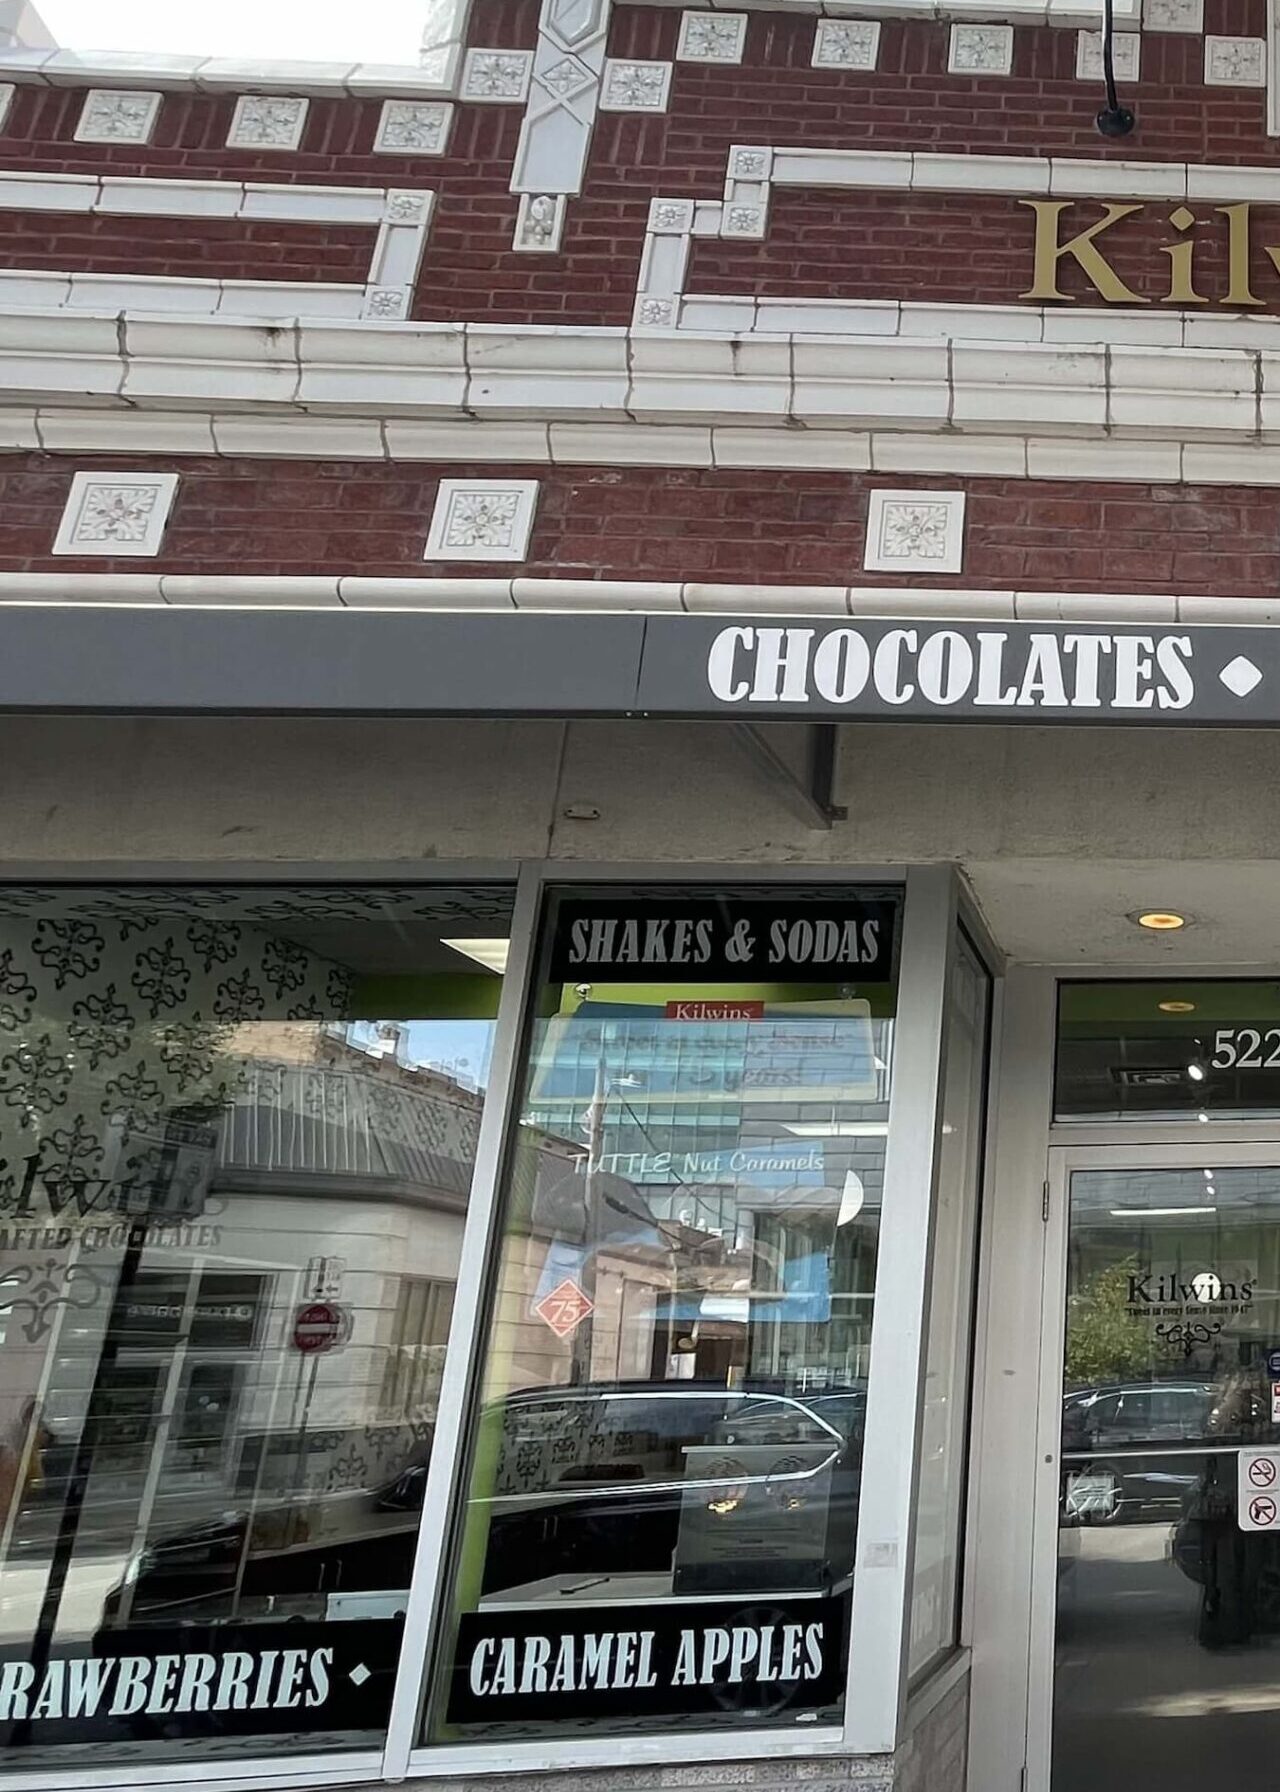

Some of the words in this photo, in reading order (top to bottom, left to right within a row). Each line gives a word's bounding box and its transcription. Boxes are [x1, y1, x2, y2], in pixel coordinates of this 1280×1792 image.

[707, 626, 1196, 710] CHOCOLATES
[568, 919, 713, 964] SHAKES
[724, 919, 757, 963] &
[768, 919, 880, 964] SODAS
[675, 1002, 751, 1021] Kilwins
[567, 1152, 673, 1175] TUTTLE
[683, 1152, 724, 1174] Nut
[729, 1148, 825, 1173] Caramels
[80, 1225, 226, 1250] CHOOLATES
[1126, 1273, 1253, 1303] Kilwins
[549, 1299, 582, 1324] 75
[468, 1630, 658, 1697] CARAMEL
[670, 1622, 824, 1686] APPLES
[0, 1647, 334, 1721] RAWBERRIES
